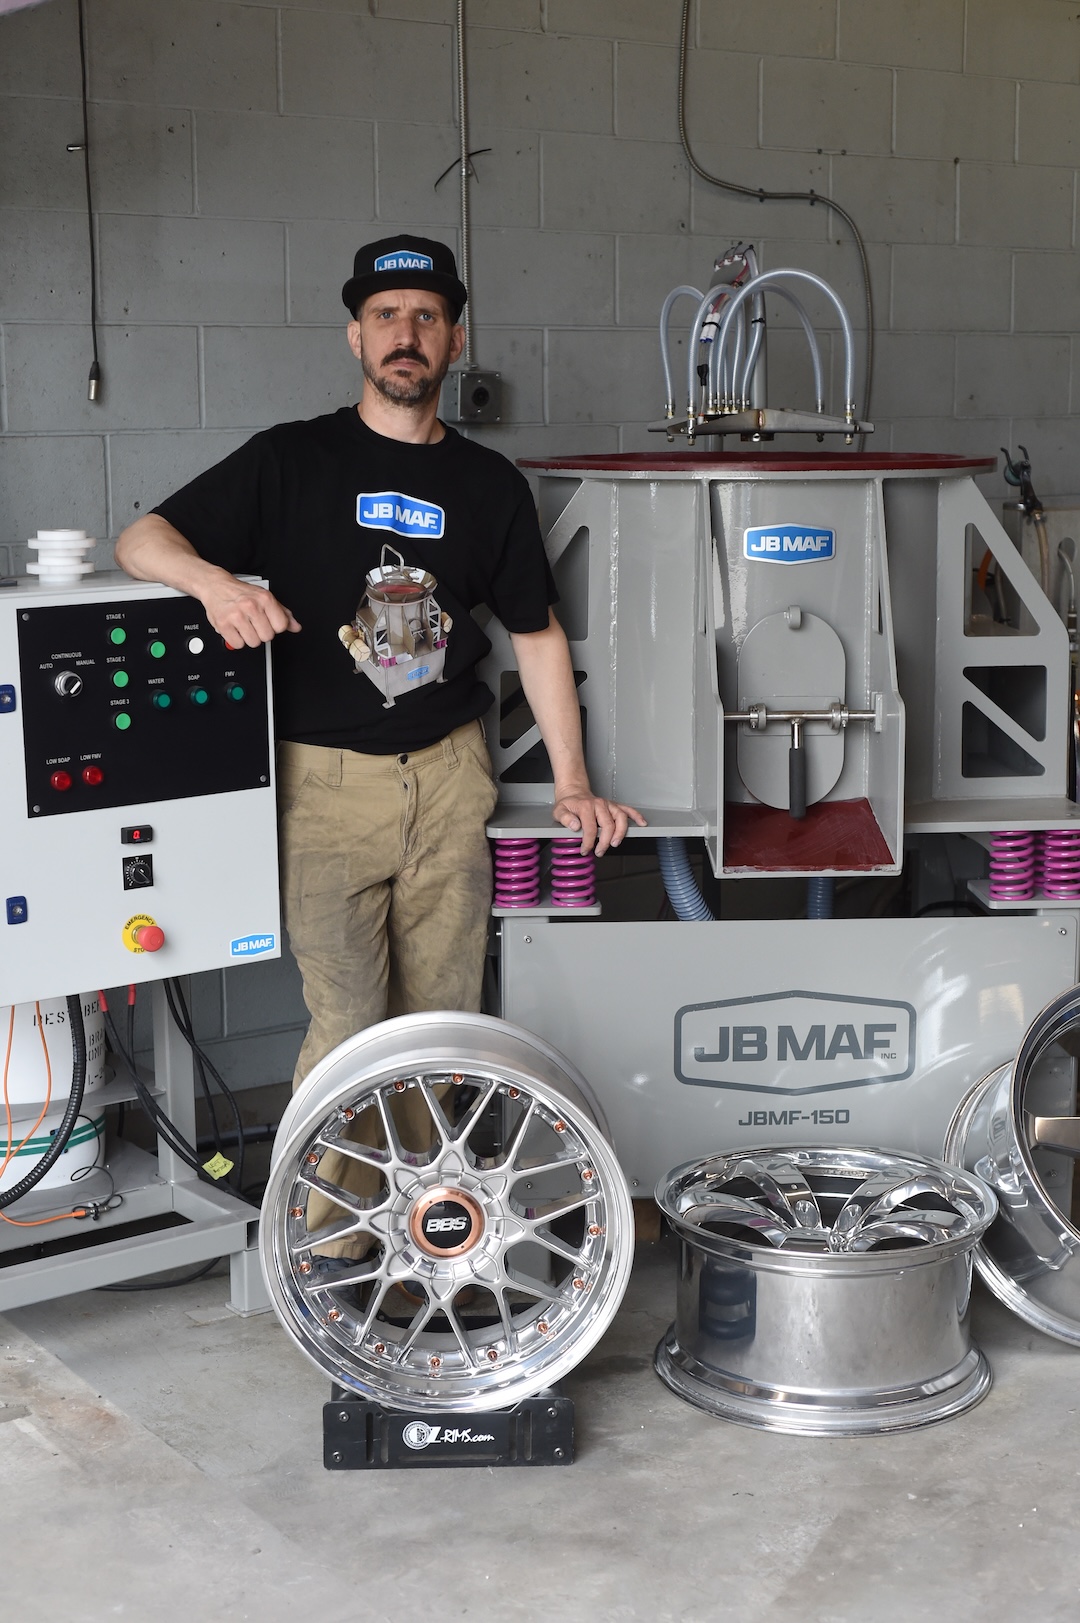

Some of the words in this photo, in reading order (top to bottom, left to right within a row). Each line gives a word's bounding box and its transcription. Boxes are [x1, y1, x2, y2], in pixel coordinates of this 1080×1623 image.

[378, 259, 396, 271] JB
[398, 258, 428, 269] MAF
[364, 503, 393, 519] JB
[395, 504, 438, 528] MAF
[751, 536, 780, 552] JB
[783, 536, 829, 552] MAF
[125, 915, 154, 930] EMERGENCY
[234, 941, 248, 952] JB
[249, 938, 272, 950] MAF
[694, 1026, 767, 1062] JB
[777, 1024, 897, 1061] MAF
[738, 1109, 850, 1126] JBMF-150
[426, 1217, 467, 1232] BBS
